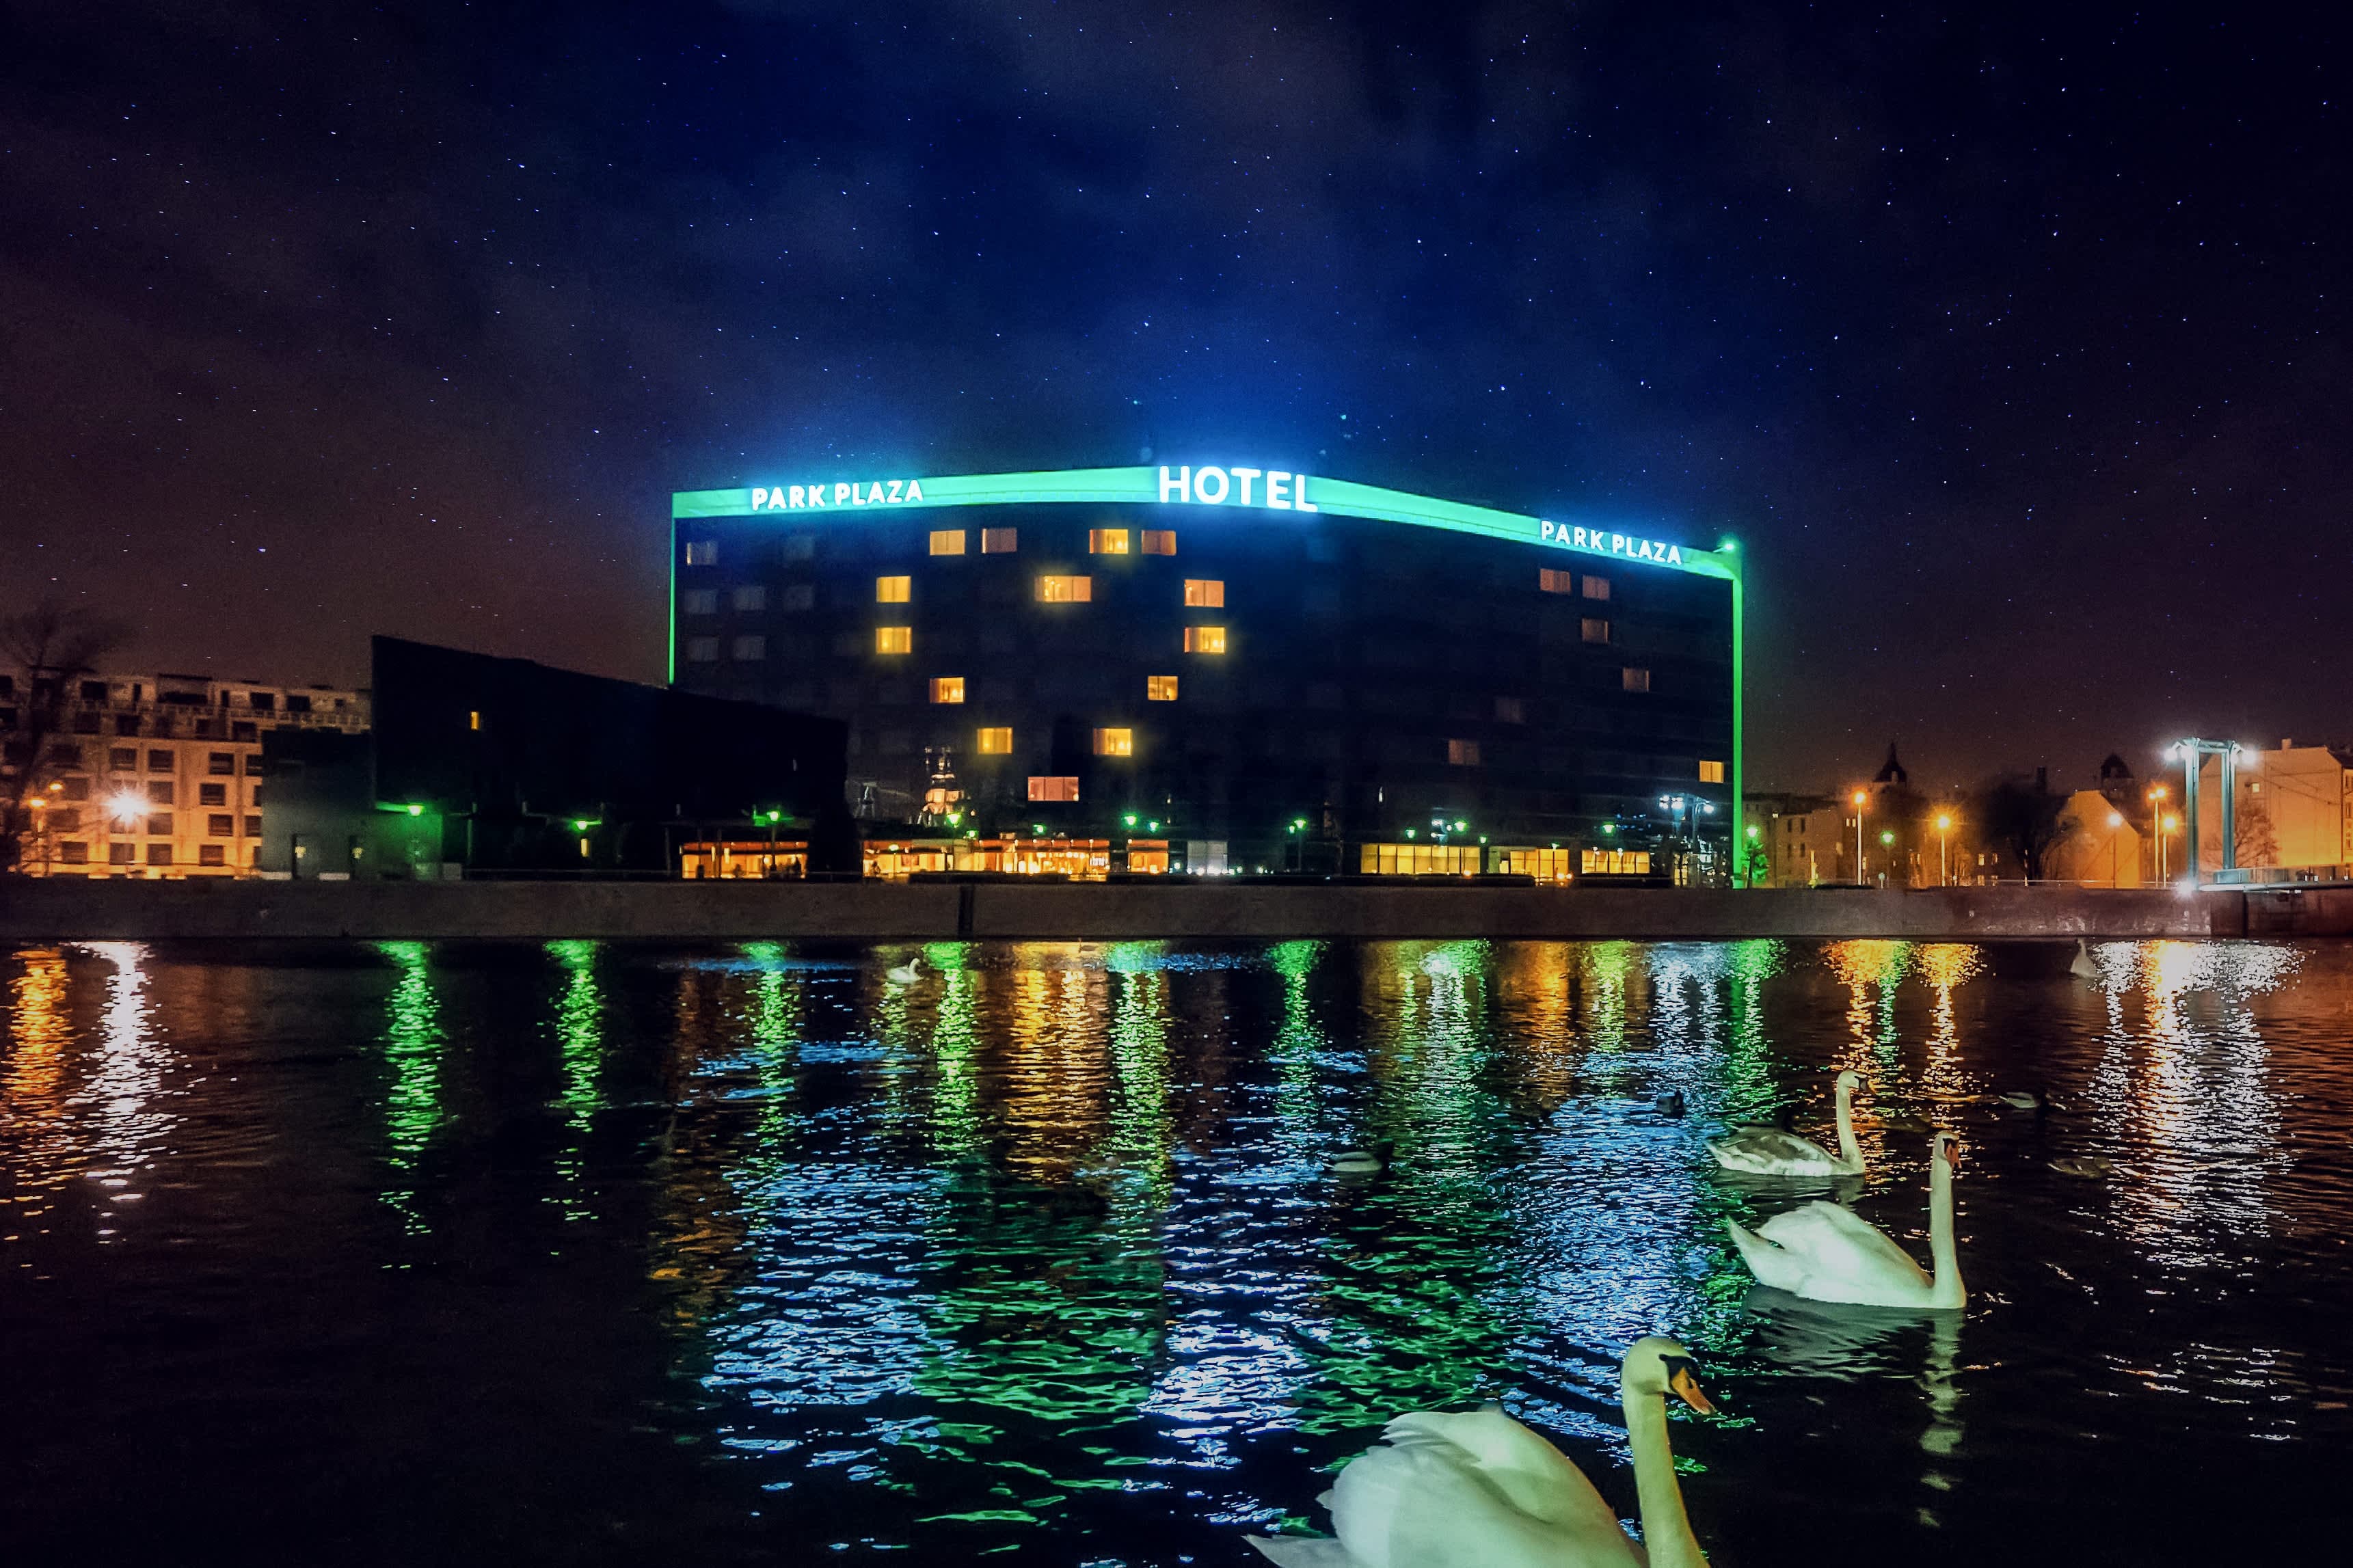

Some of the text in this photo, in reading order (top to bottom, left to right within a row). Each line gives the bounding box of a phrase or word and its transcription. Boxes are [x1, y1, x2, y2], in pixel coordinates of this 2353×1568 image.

[752, 479, 924, 511] PARK PLAZA
[1159, 465, 1319, 513] HOTEL
[1541, 520, 1682, 565] PARK PLAZA
